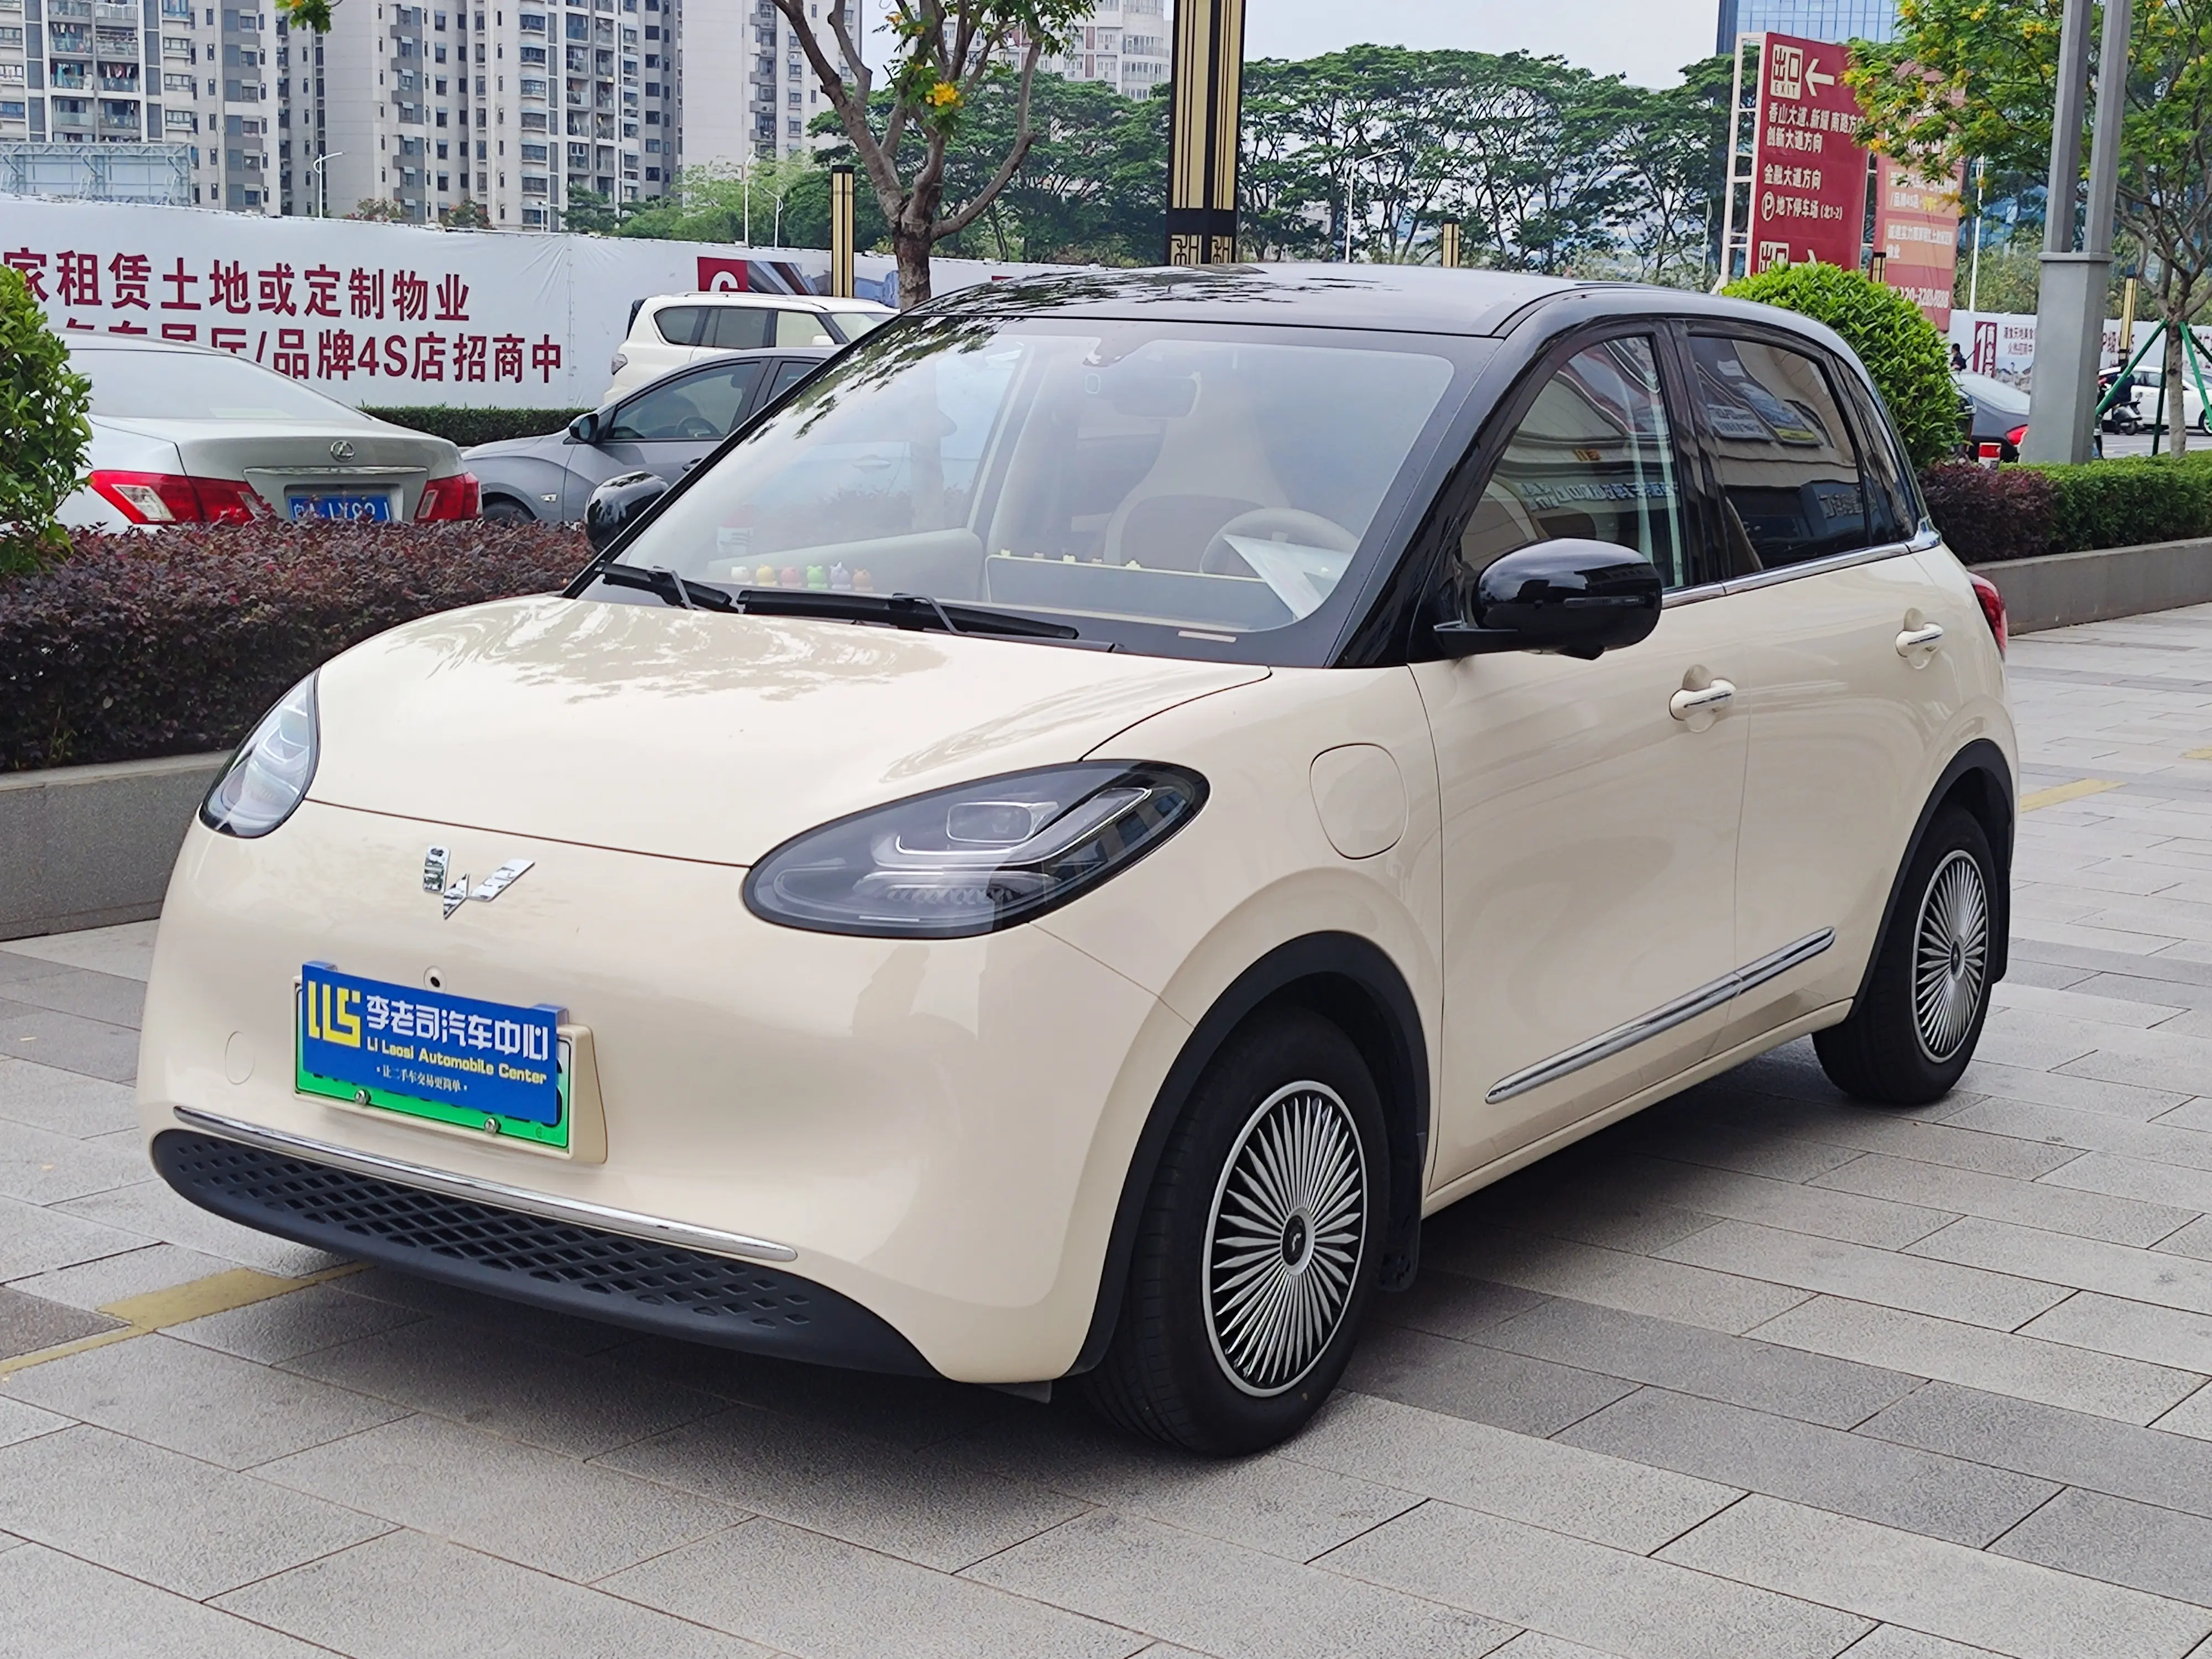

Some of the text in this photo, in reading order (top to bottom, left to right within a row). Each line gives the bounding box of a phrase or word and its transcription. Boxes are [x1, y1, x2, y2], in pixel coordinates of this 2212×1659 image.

[1773, 48, 1801, 83] 出口
[1775, 82, 1797, 96] EXIT
[4, 247, 470, 322] 家租赁土地或定制物业
[367, 995, 549, 1062] 李老司汽车中心
[367, 1036, 378, 1052] Li
[418, 1047, 494, 1076] Automobile
[498, 1062, 547, 1086] Center
